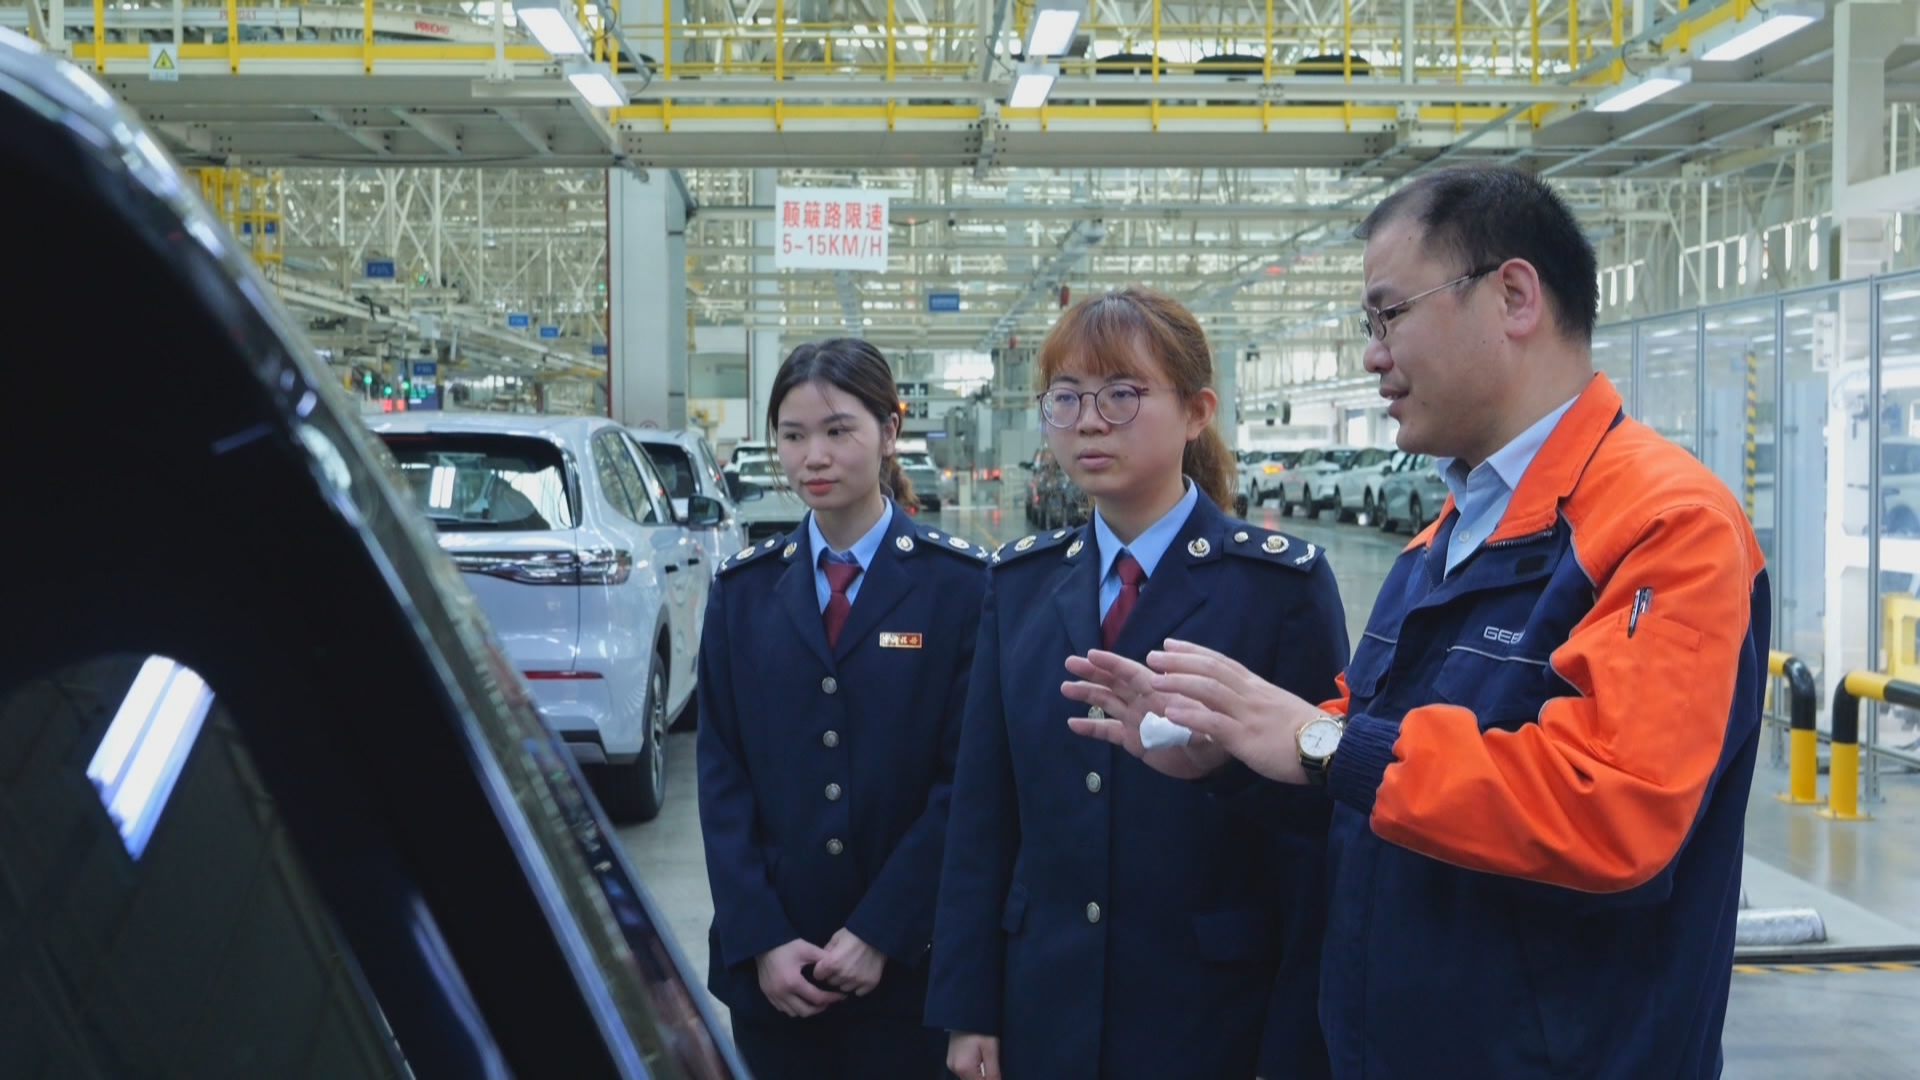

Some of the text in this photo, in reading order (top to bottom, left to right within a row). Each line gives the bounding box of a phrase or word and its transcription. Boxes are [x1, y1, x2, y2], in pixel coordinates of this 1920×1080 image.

[783, 201, 882, 230] 颠簸路限速
[1483, 626, 1525, 644] GEE
